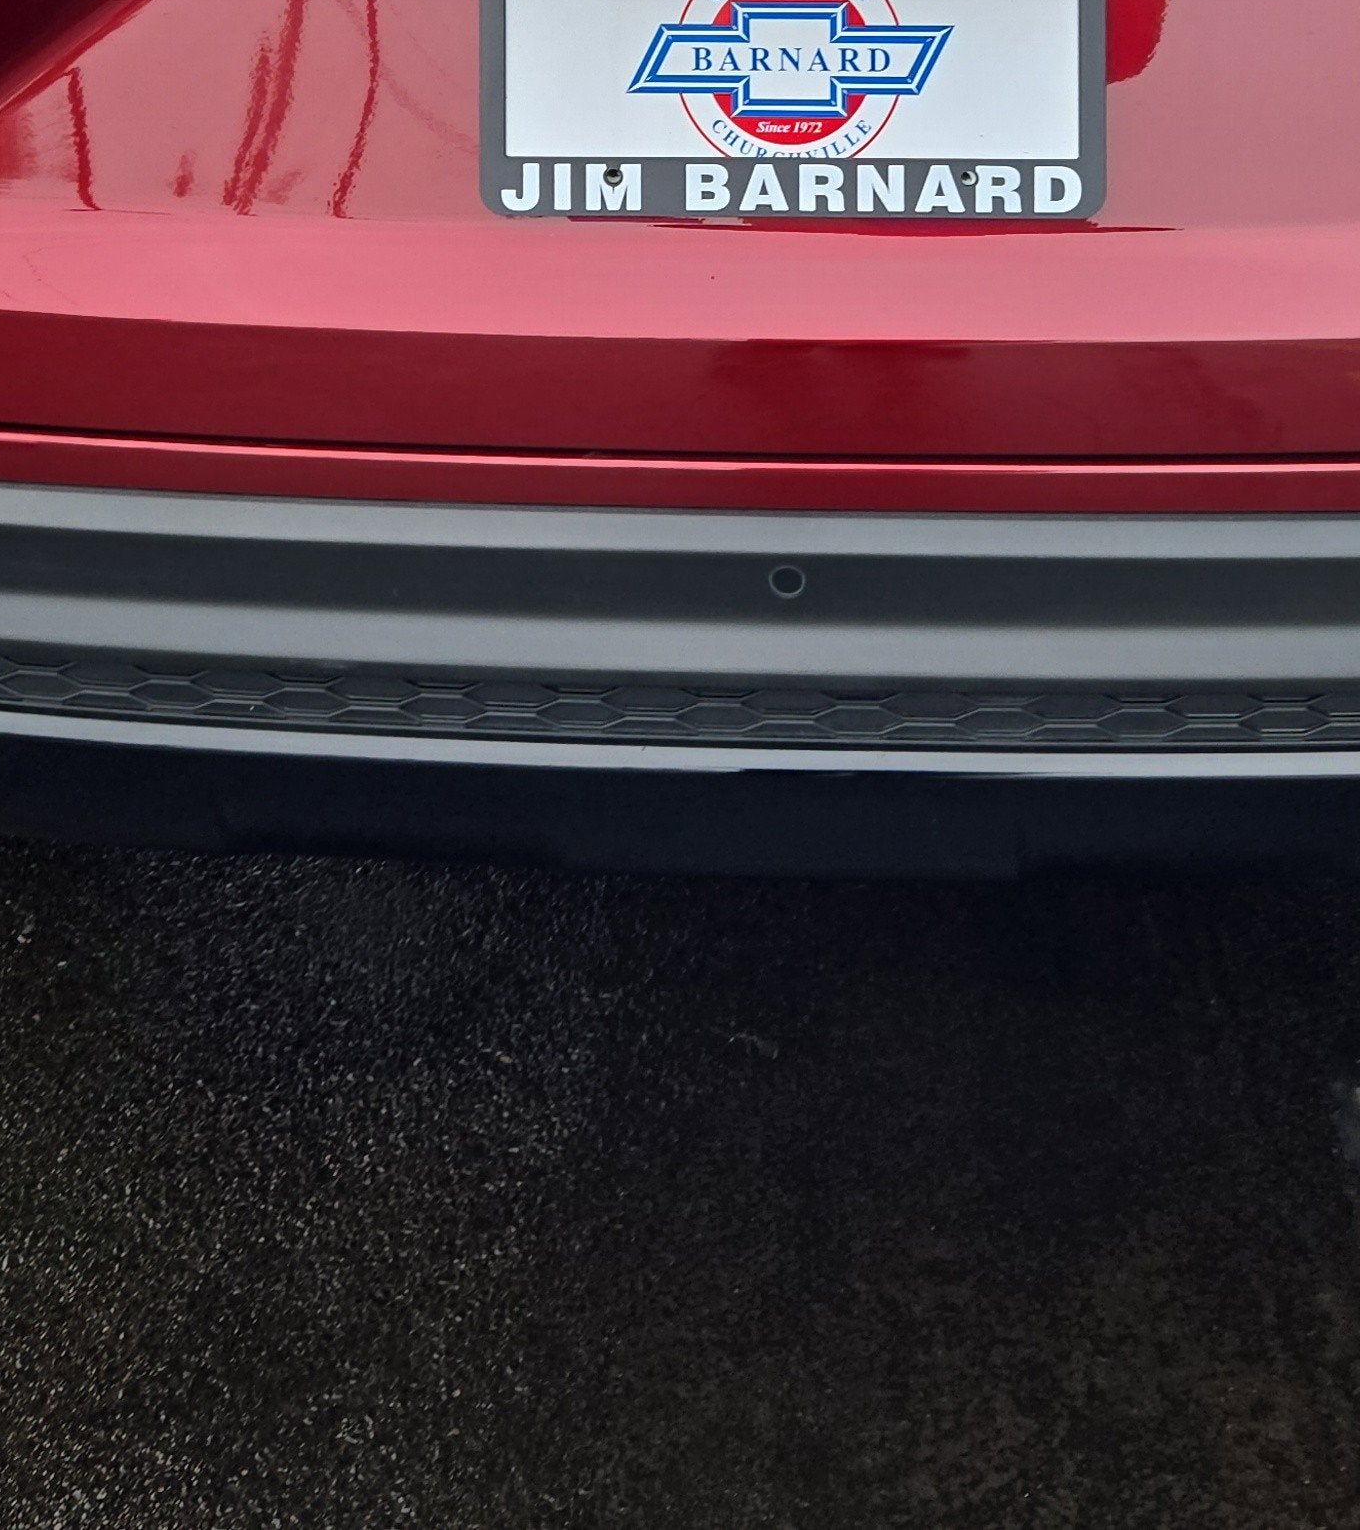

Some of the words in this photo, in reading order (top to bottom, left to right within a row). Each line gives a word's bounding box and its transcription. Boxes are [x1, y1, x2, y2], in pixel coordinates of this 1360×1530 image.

[692, 46, 892, 73] BARNARD
[756, 120, 791, 133] Since
[793, 121, 823, 134] 1972
[501, 162, 643, 212] JIM
[685, 164, 1083, 214] BARNARD
